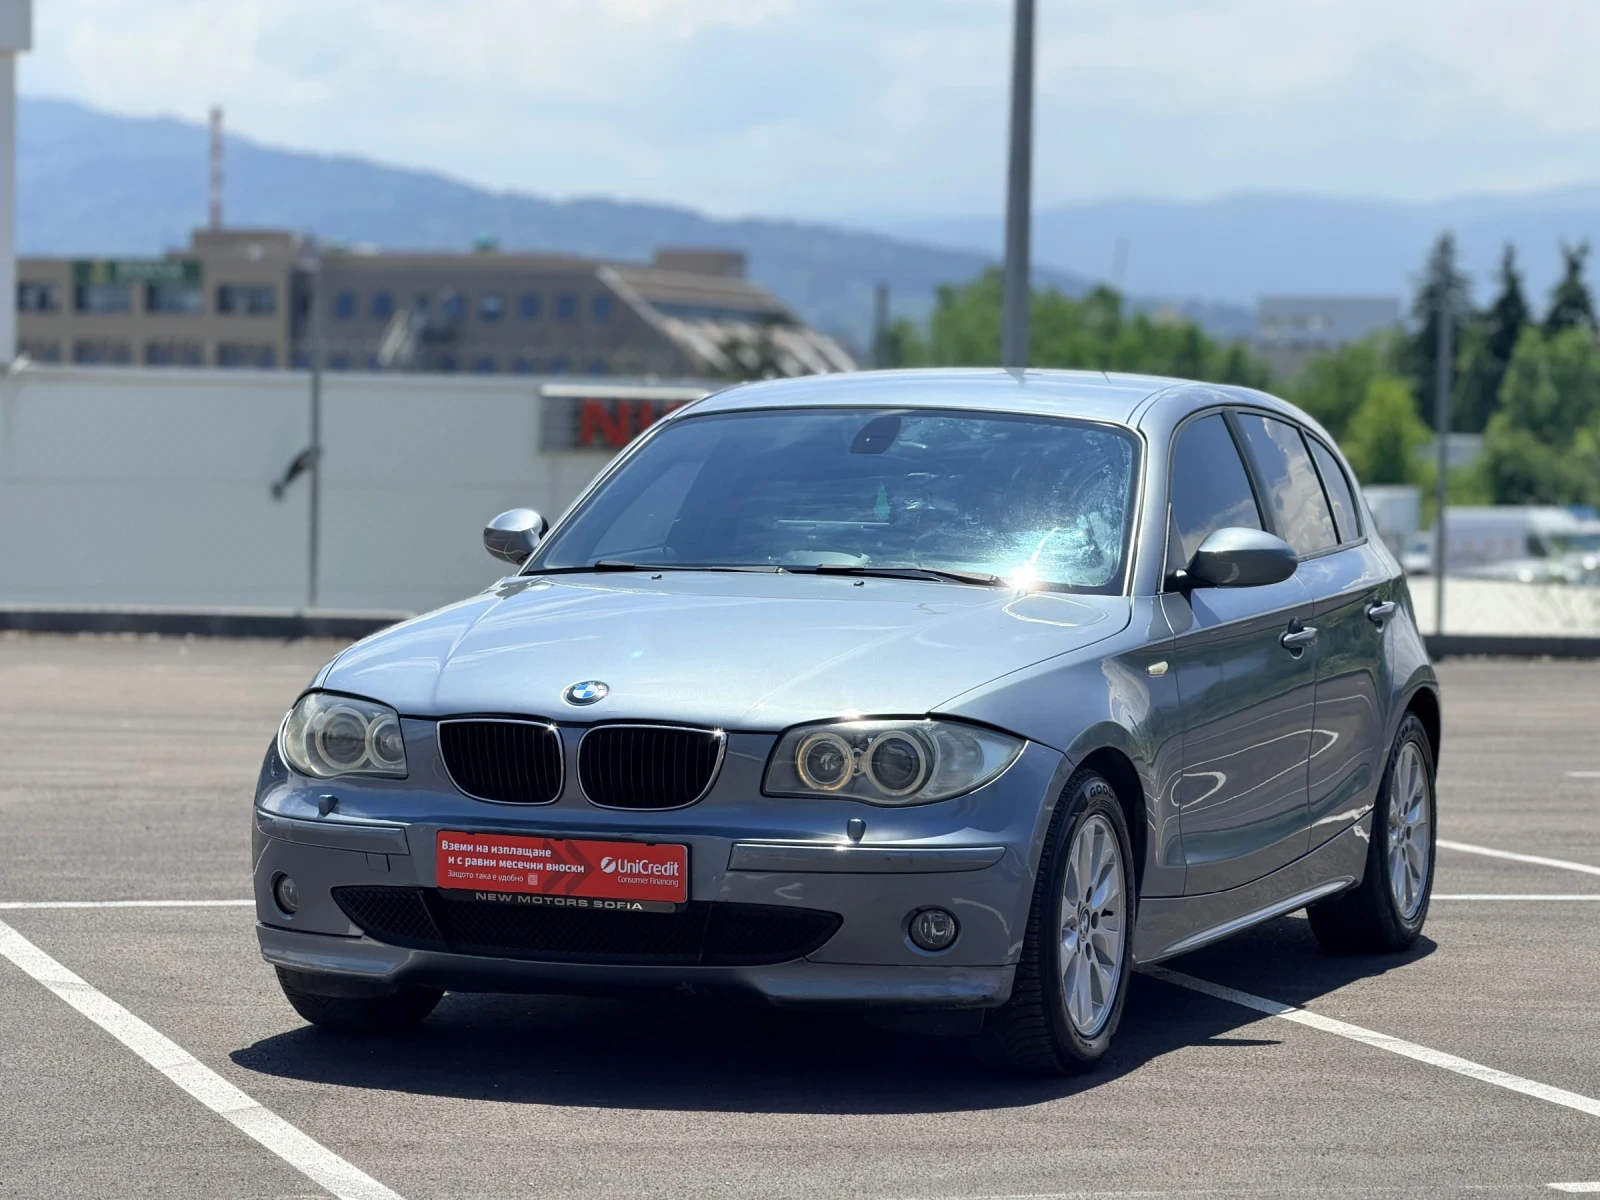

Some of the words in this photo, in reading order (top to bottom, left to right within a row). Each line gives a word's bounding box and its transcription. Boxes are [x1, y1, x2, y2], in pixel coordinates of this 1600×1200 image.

[442, 840, 474, 852] Вземи
[476, 844, 489, 853] на
[491, 845, 552, 858] изплащане
[448, 856, 455, 864] и
[457, 856, 463, 865] с
[465, 857, 497, 868] равни
[499, 859, 544, 871] месечни
[546, 862, 585, 873] вноски
[617, 858, 679, 877] UniCredit
[447, 869, 474, 879] Защото
[498, 874, 524, 883] удобно
[617, 875, 649, 885] Consumer
[649, 877, 679, 888] Financing
[475, 892, 513, 902] NEW
[517, 895, 589, 907] MOTORS
[593, 900, 643, 910] SOFIA
